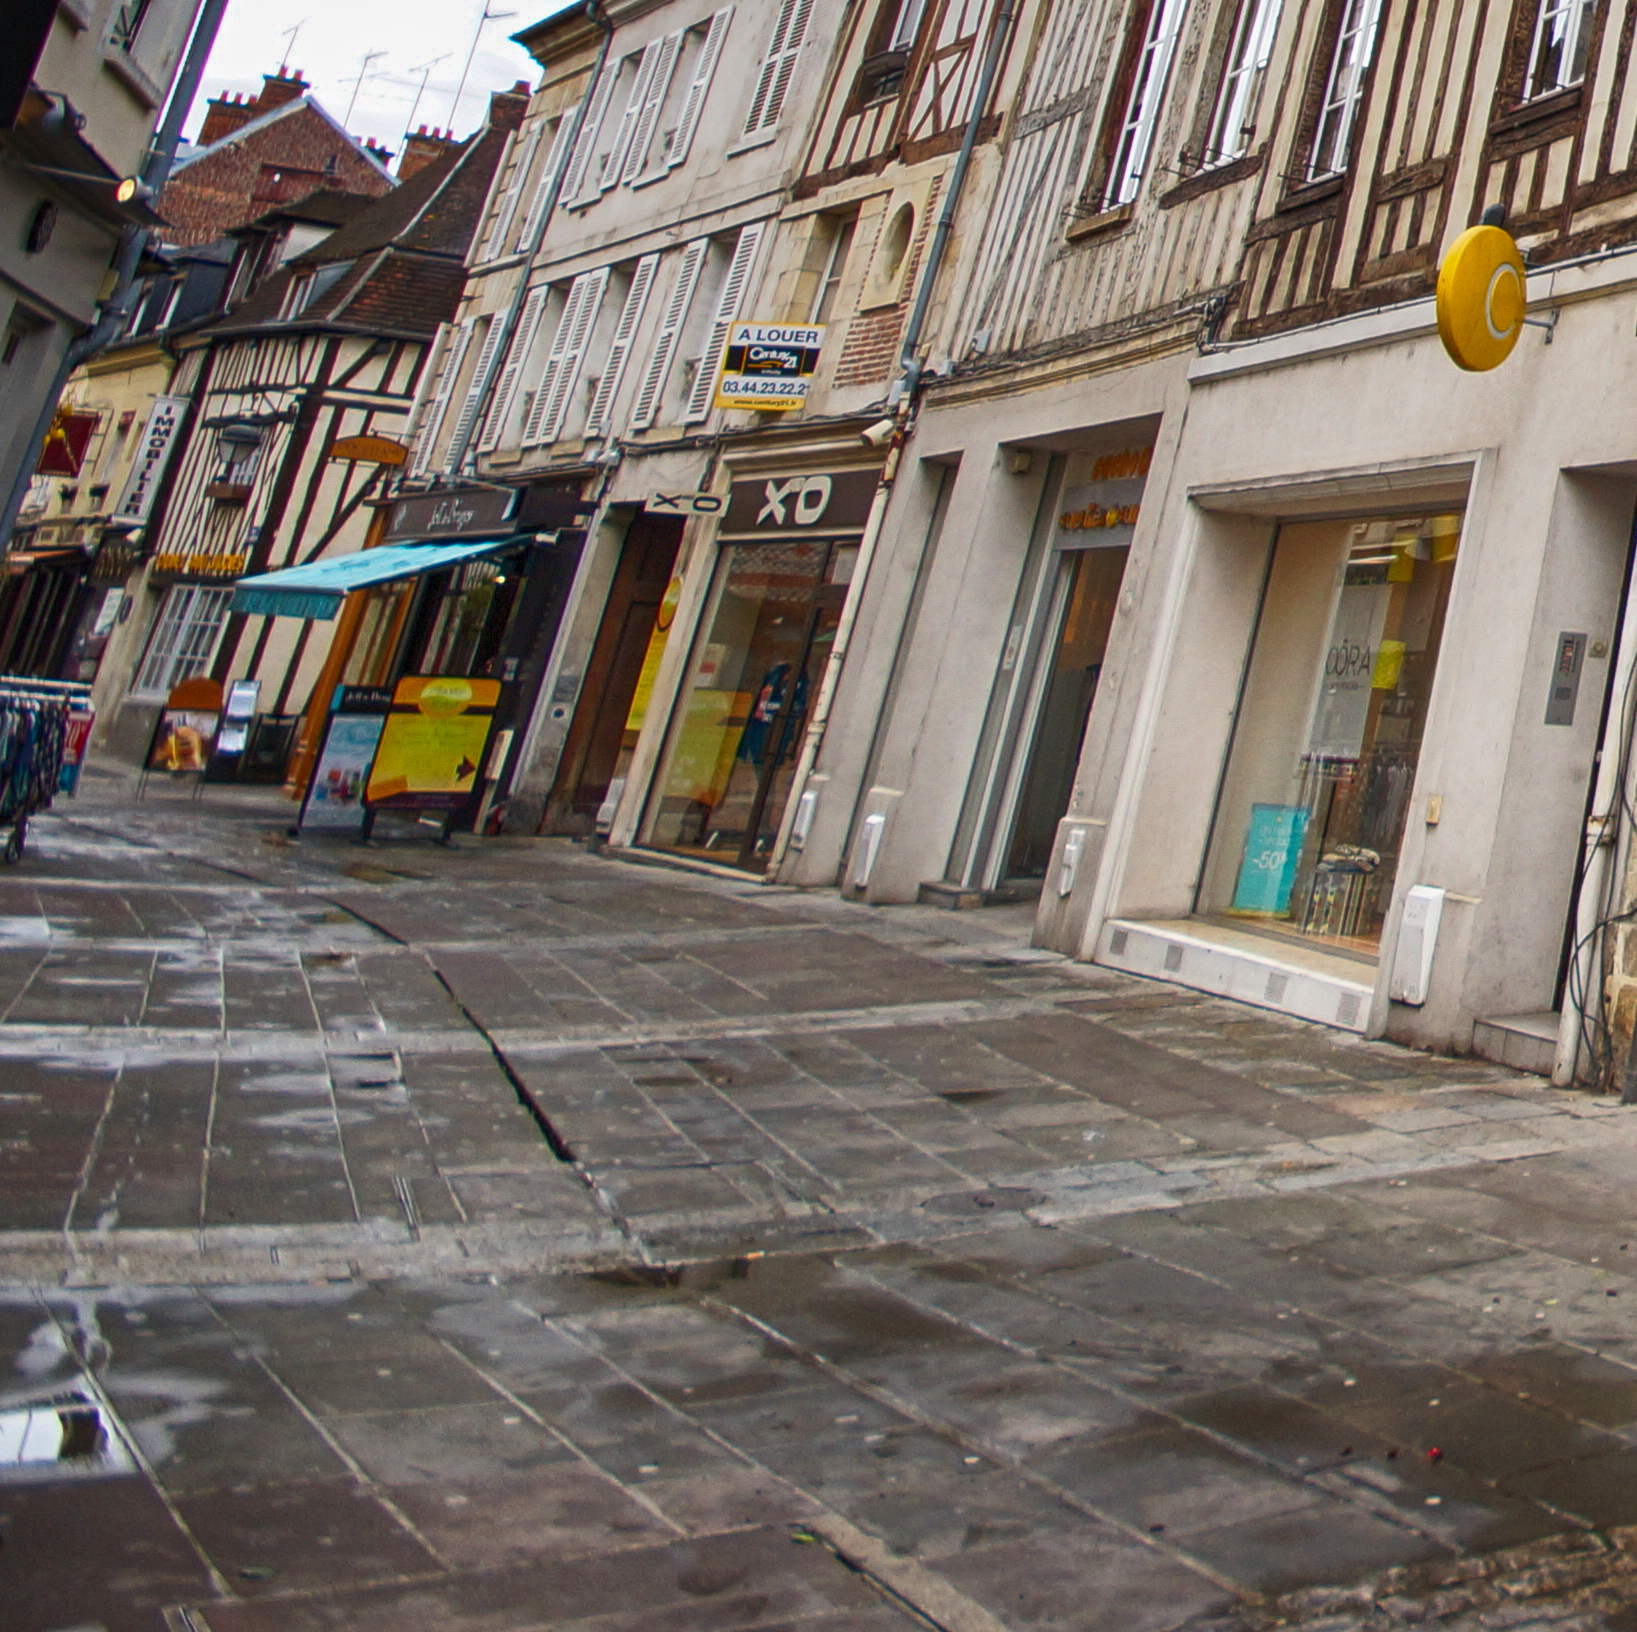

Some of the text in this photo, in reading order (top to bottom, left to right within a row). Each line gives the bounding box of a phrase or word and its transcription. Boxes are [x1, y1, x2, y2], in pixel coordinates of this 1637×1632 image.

[738, 328, 819, 344] A LOUER
[749, 346, 798, 368] Century 21
[722, 380, 811, 396] 03.44.23.22.2
[124, 405, 176, 516] IMMOBILIER
[756, 475, 833, 526] XO
